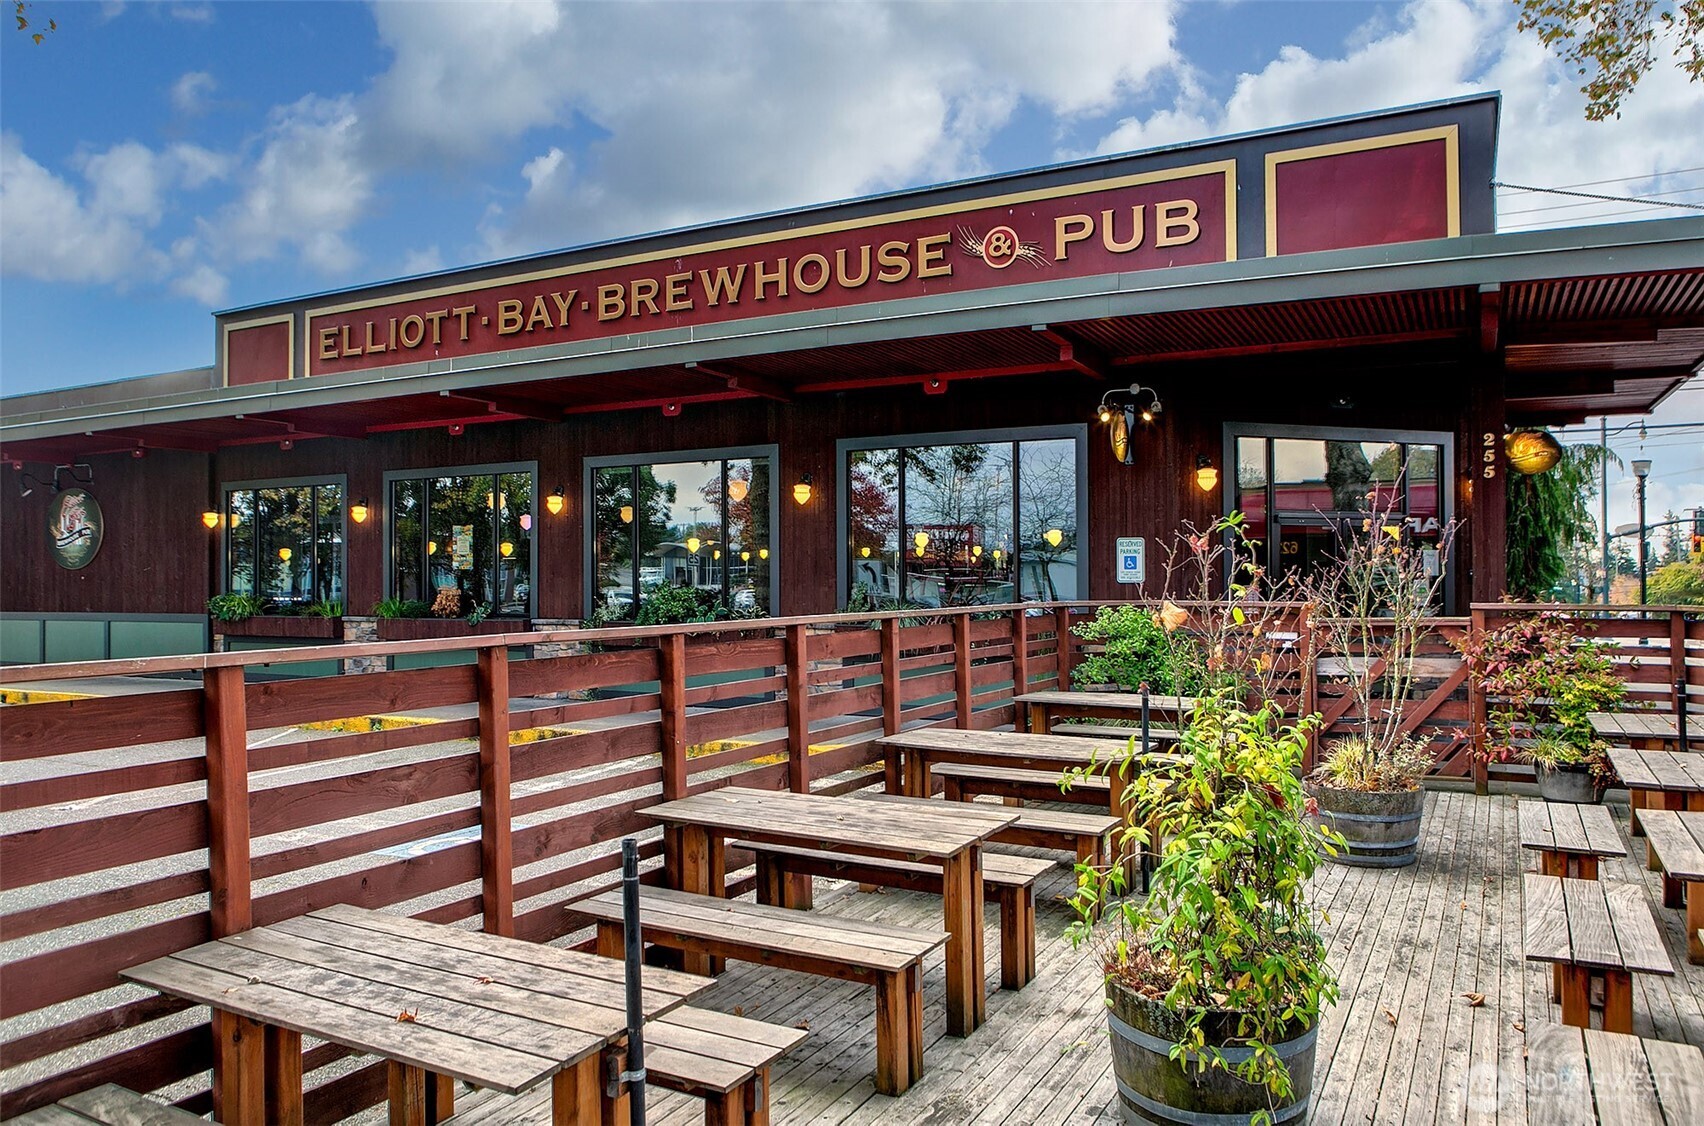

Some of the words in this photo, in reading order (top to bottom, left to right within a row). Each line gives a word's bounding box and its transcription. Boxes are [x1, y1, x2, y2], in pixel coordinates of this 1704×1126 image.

[319, 304, 475, 360] ELLIOTT
[498, 289, 578, 335] BAY
[598, 232, 952, 322] BREWHOUSE
[990, 233, 1011, 257] &
[1054, 199, 1200, 261] PUB
[1483, 433, 1496, 478] 255
